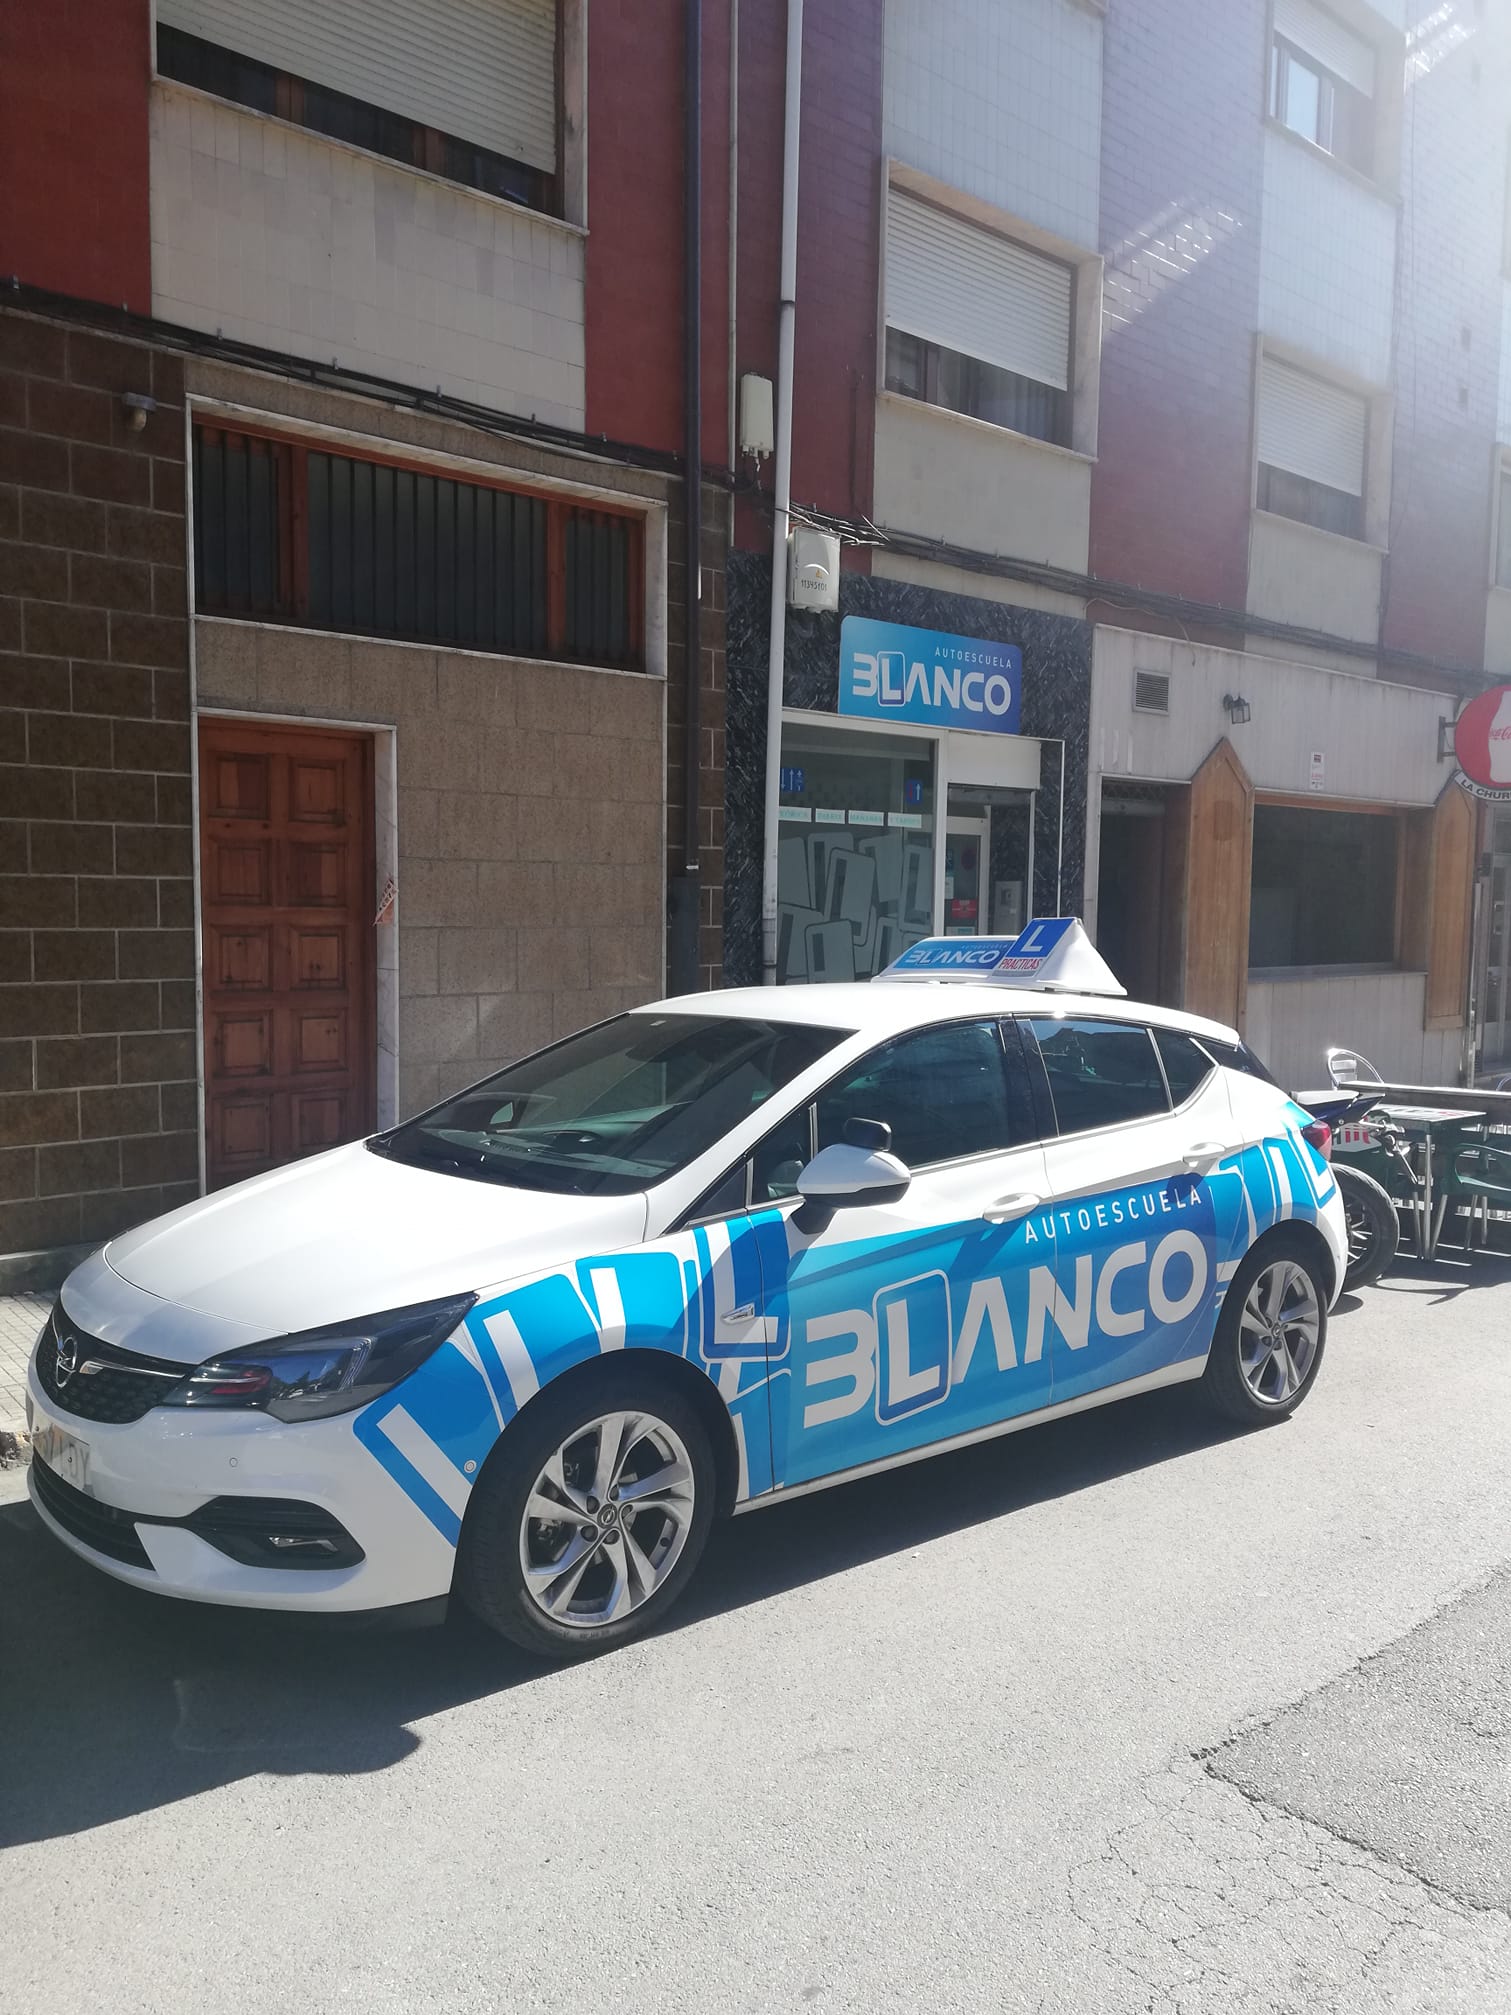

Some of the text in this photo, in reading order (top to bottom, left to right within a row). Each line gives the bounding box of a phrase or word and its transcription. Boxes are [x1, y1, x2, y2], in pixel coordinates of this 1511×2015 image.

[935, 647, 1012, 669] AUTOESCUELA
[852, 651, 1012, 716] BLANCO
[1461, 780, 1511, 800] LA CHUR
[1020, 924, 1045, 952] L
[905, 949, 1000, 966] BLANCO
[1025, 1185, 1202, 1244] AUTOESCUELA
[803, 1229, 1207, 1429] BLANCO
